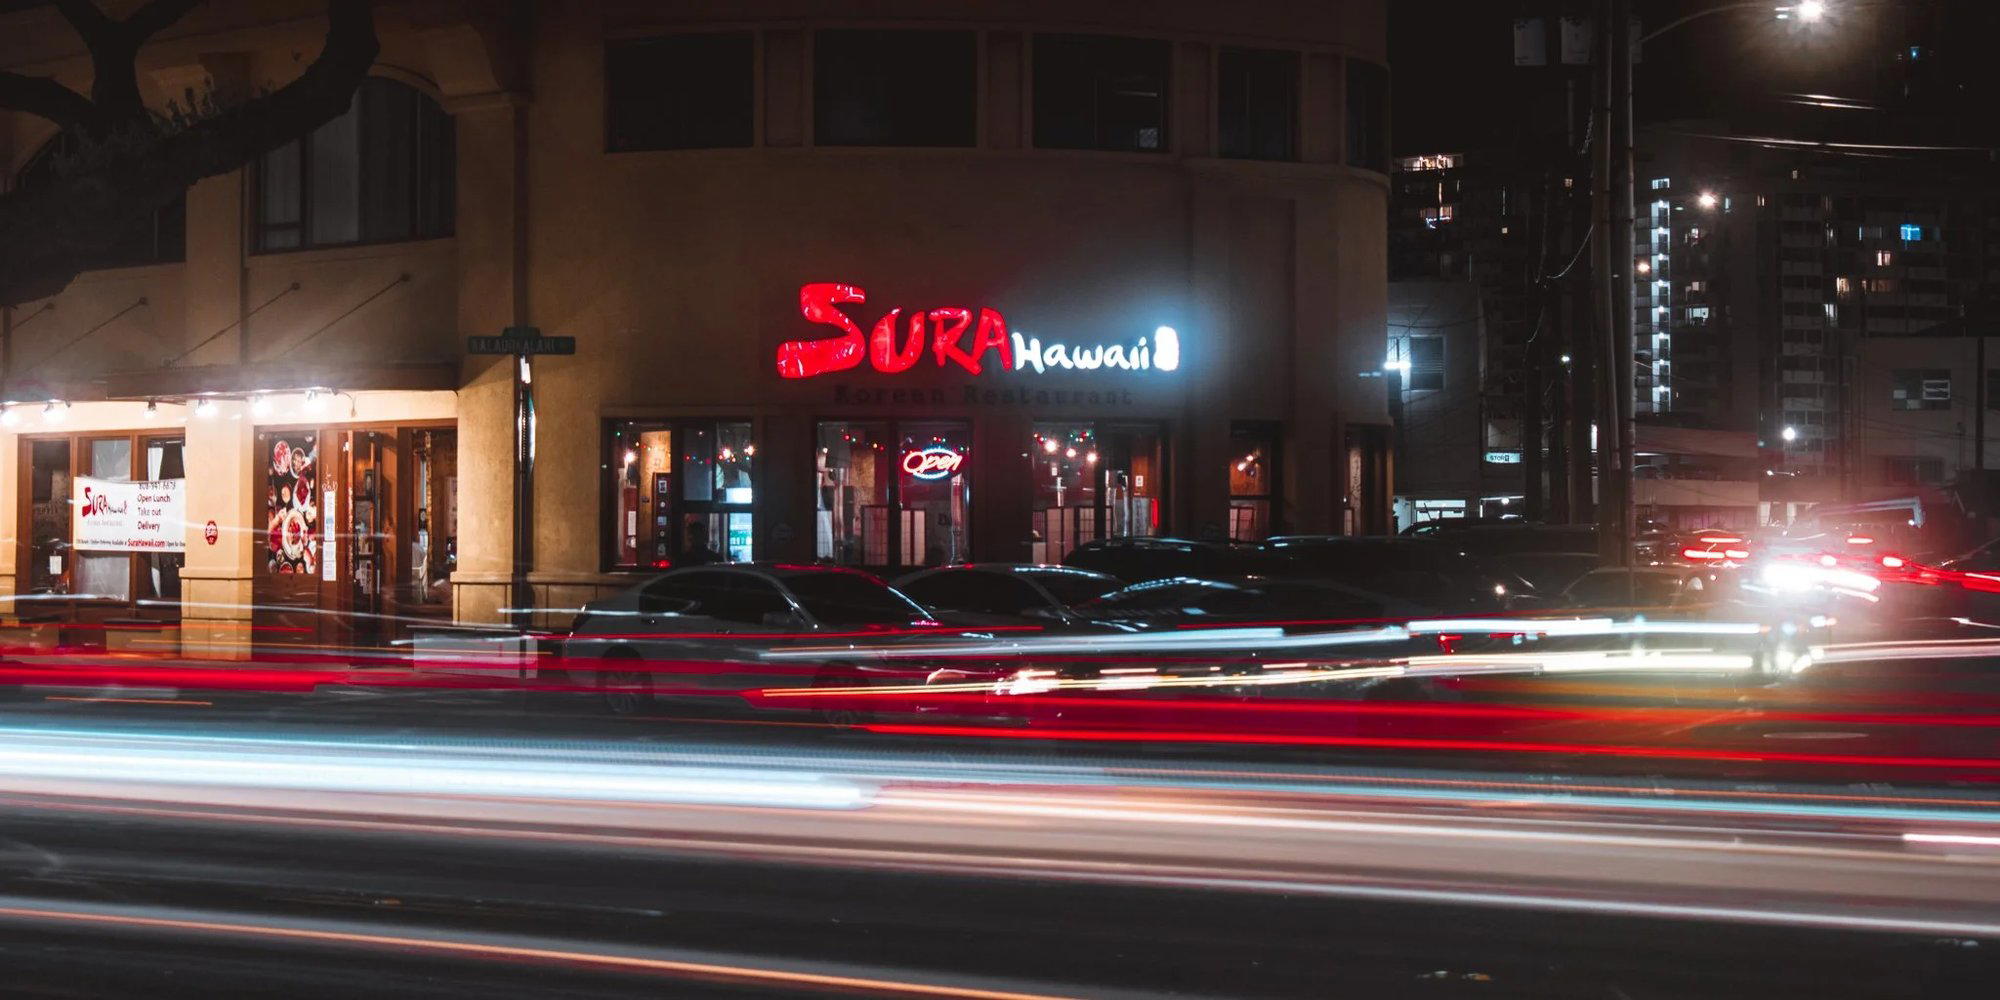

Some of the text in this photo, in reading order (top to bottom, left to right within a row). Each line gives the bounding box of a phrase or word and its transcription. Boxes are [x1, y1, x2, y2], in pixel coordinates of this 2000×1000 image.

[777, 282, 1149, 379] SURA Hawaii
[834, 385, 1134, 405] Korean Restaurant
[903, 451, 963, 474] Open
[137, 493, 171, 504] Open Lunch
[137, 521, 160, 533] Delivery
